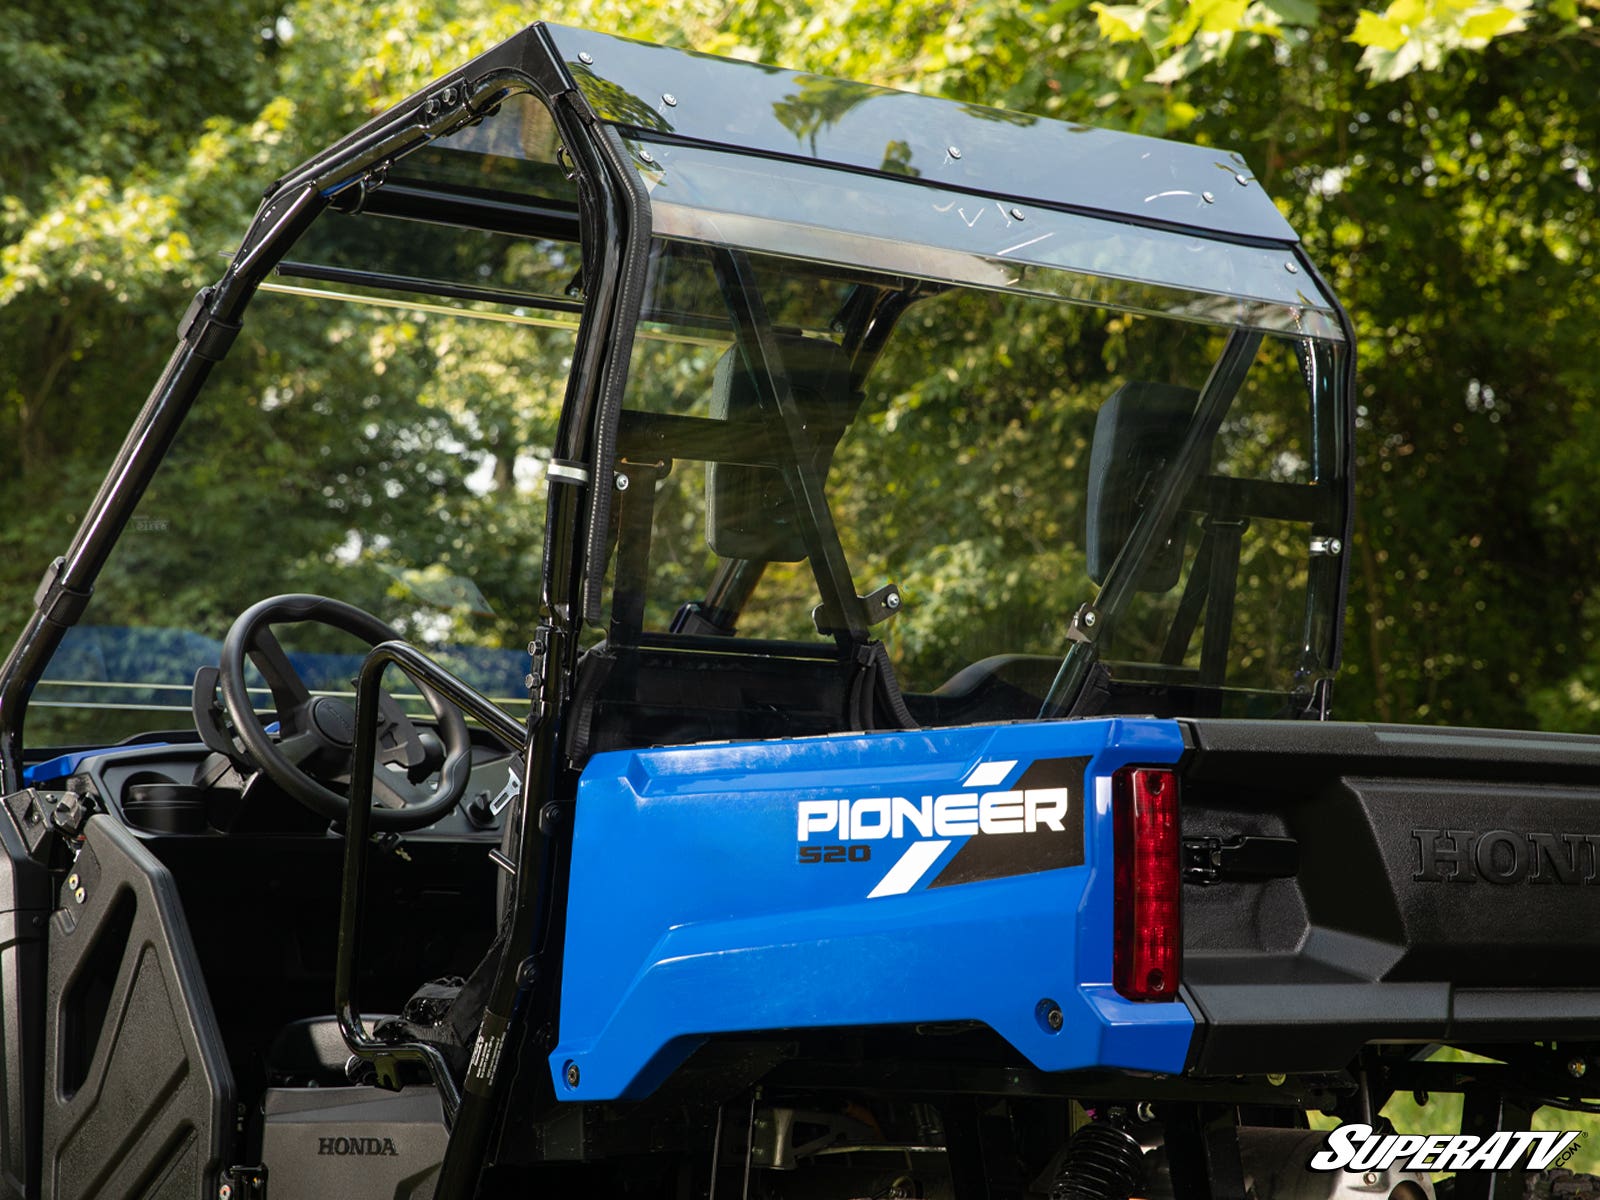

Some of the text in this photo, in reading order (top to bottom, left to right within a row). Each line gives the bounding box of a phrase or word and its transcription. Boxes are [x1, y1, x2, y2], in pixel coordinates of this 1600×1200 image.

[798, 788, 1068, 842] PIONEER
[799, 845, 871, 863] 520
[1412, 829, 1600, 885] HON
[317, 1136, 399, 1156] HONDA
